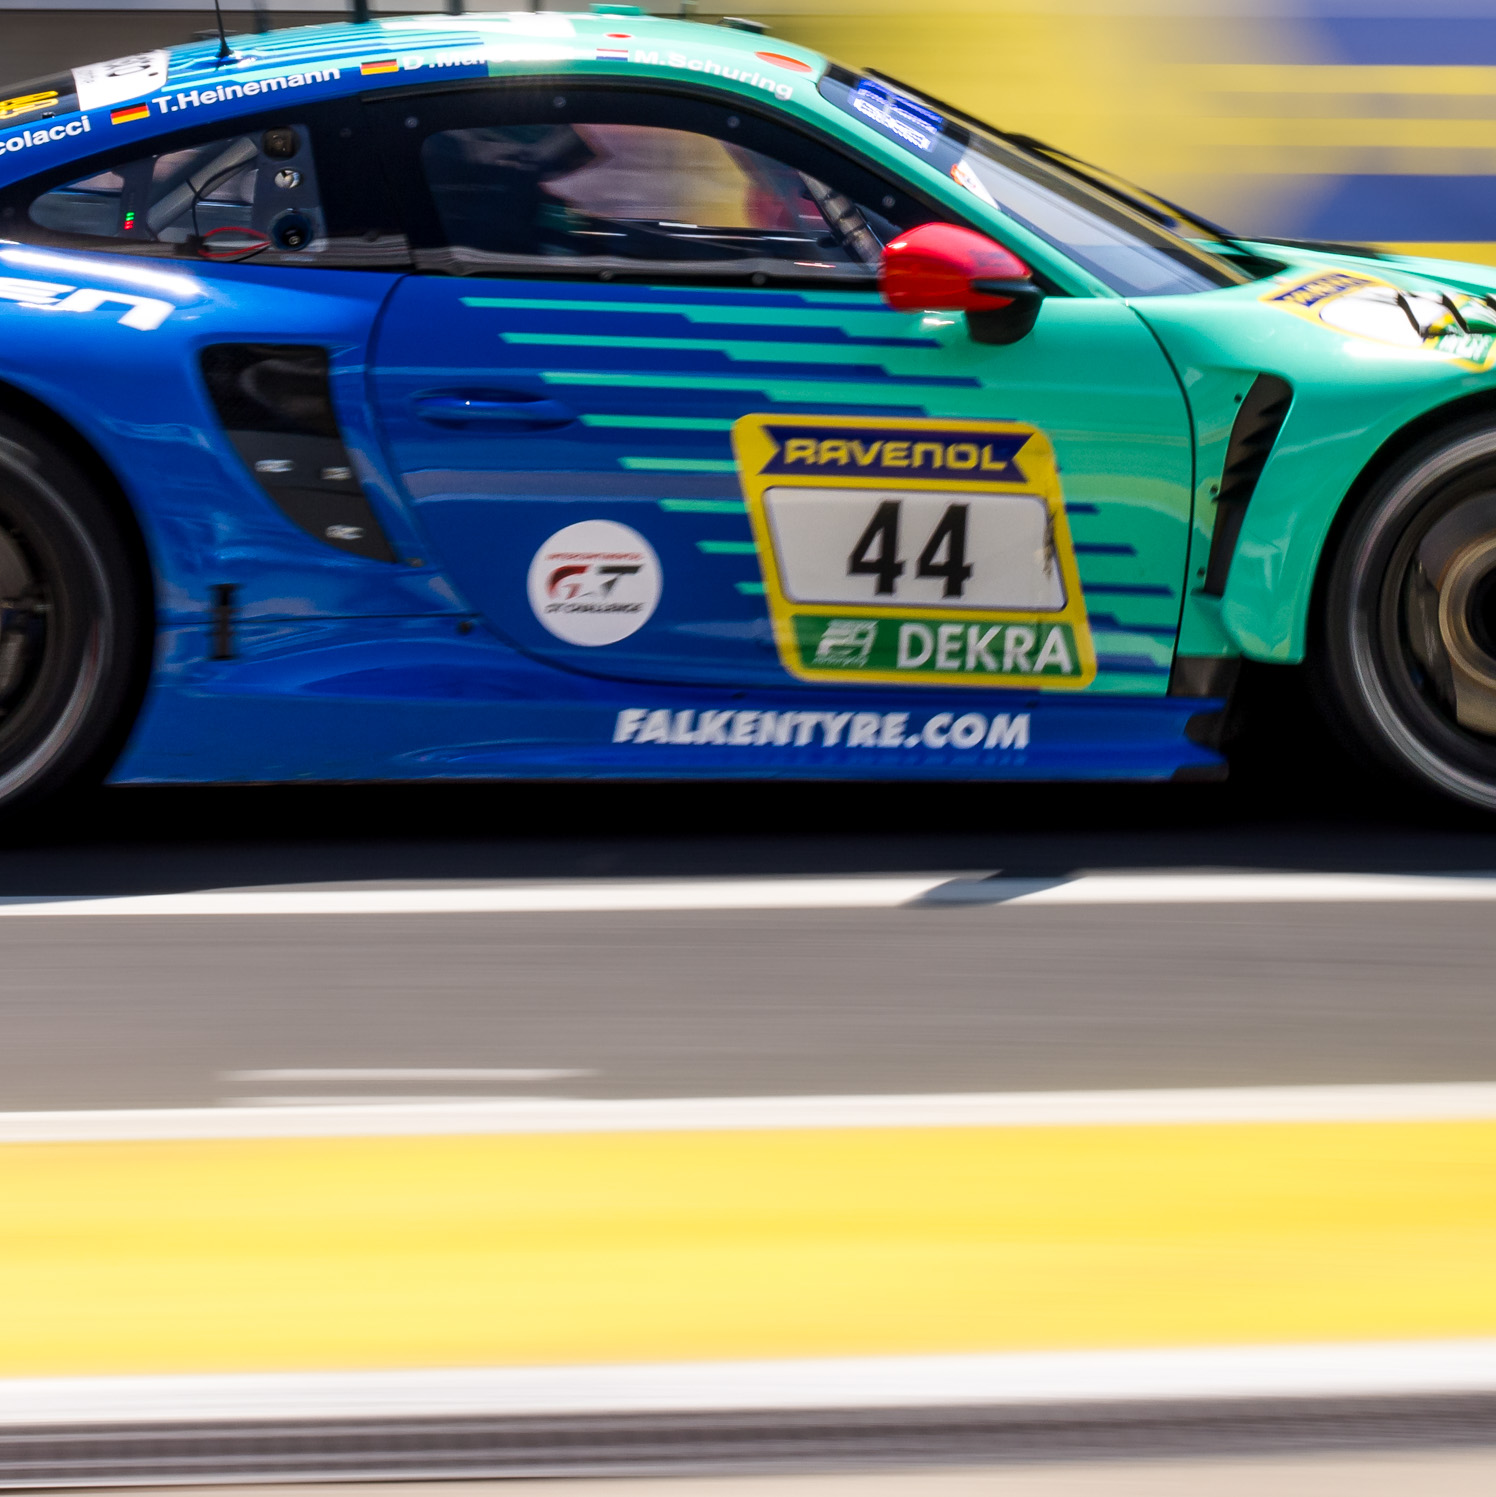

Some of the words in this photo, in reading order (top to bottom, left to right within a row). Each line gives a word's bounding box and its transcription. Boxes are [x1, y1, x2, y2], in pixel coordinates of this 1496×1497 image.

[152, 67, 341, 115] T.Heinemann
[784, 437, 1007, 472] RAVENOL
[846, 499, 974, 599] 44
[896, 621, 1073, 675] DEKRA
[612, 707, 1031, 750] FALKENTYRE.COM
